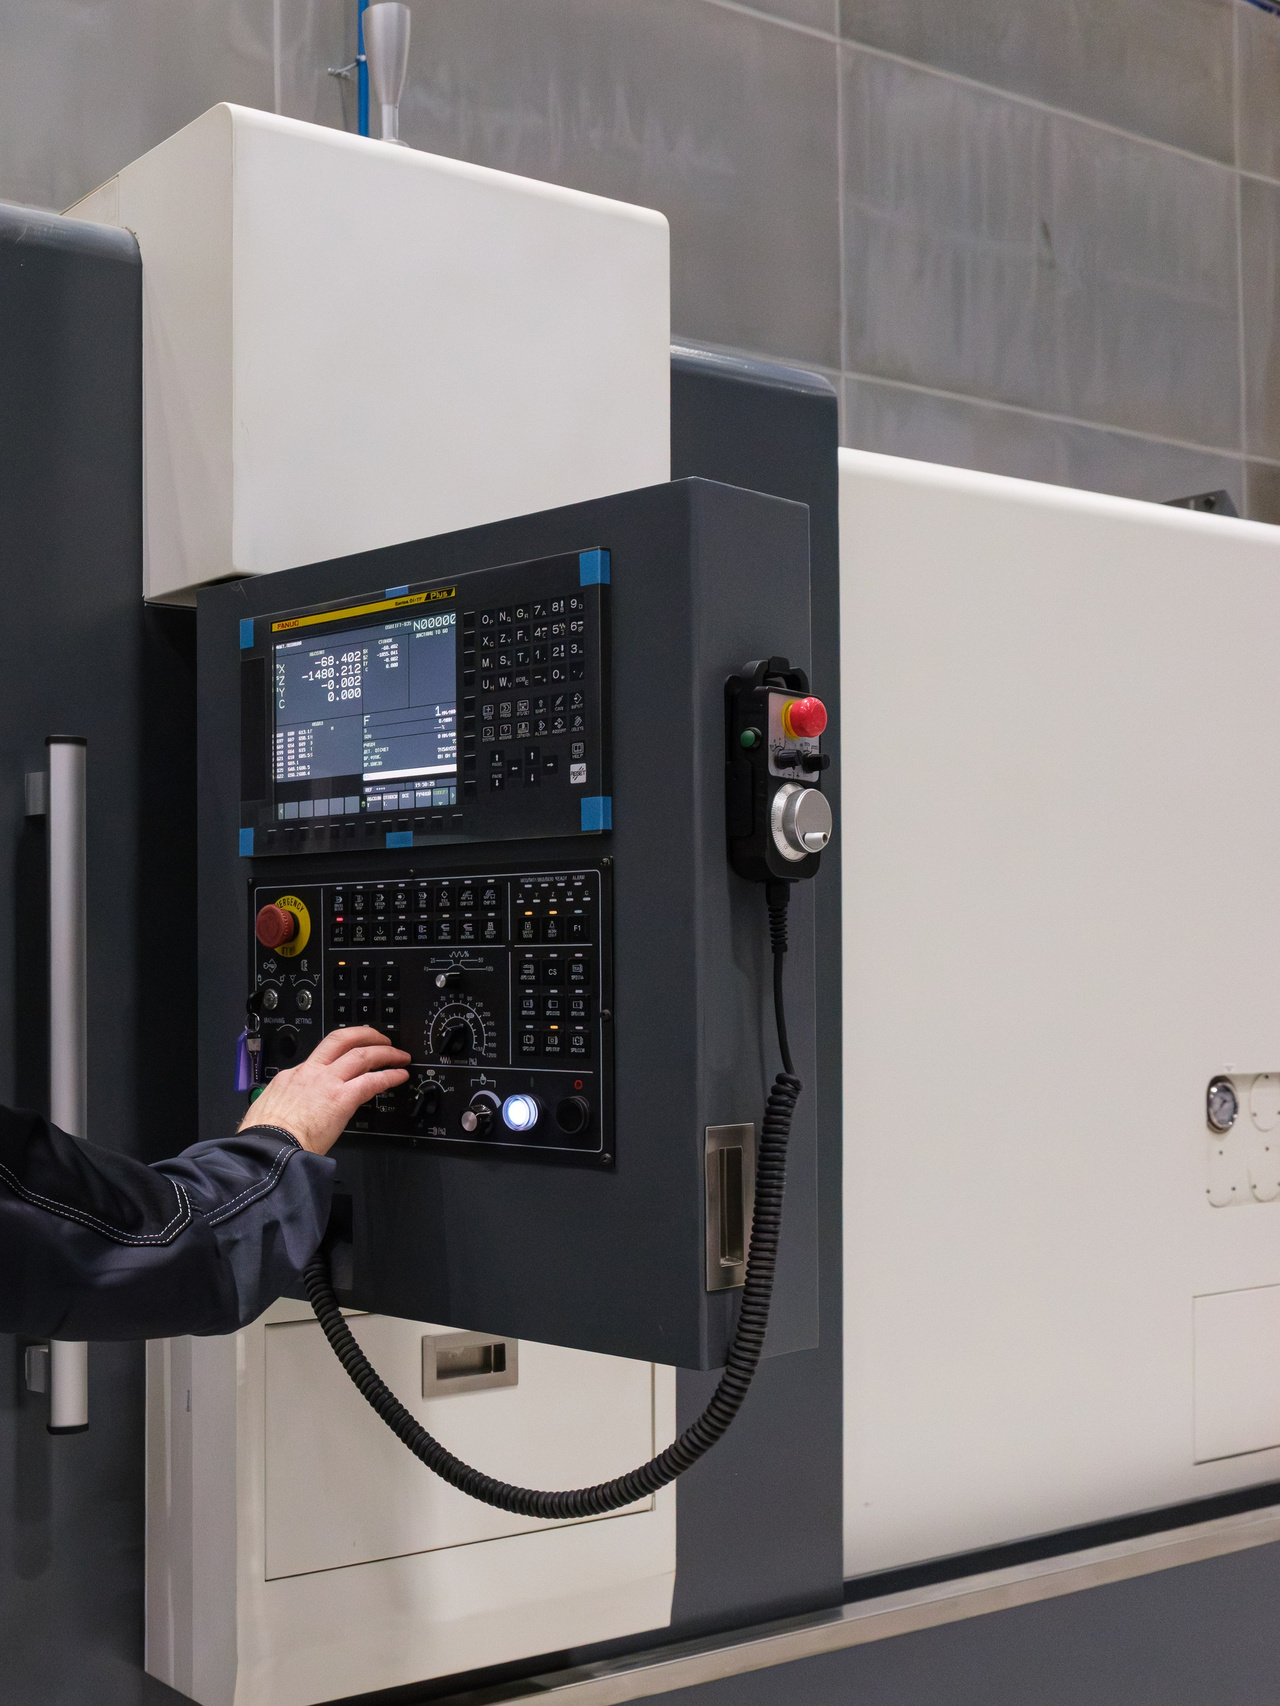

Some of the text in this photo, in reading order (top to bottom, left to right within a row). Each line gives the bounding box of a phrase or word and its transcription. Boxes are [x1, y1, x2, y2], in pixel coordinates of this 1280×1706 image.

[552, 602, 558, 612] 8
[570, 599, 577, 608] 9
[517, 609, 523, 618] G
[534, 606, 540, 614] 7
[482, 615, 489, 624] O
[500, 612, 506, 621] N
[277, 620, 299, 629] FANUC
[570, 622, 577, 631] 6
[535, 628, 540, 636] 4
[552, 625, 559, 634] 5
[500, 634, 506, 642] Z
[517, 631, 523, 640] F
[483, 637, 488, 646] X
[553, 648, 559, 657] 2
[571, 644, 577, 653] 3
[315, 651, 361, 666] -68.402
[500, 656, 506, 664] S
[517, 653, 524, 661] T
[482, 659, 489, 668] M
[302, 664, 361, 681] -1480.212
[553, 670, 559, 679] 0
[321, 676, 361, 689] -0.002
[483, 680, 489, 689] U
[499, 677, 507, 686] W
[279, 688, 361, 709] C 0.000
[364, 716, 371, 726] F
[276, 897, 305, 912] ERGENCY
